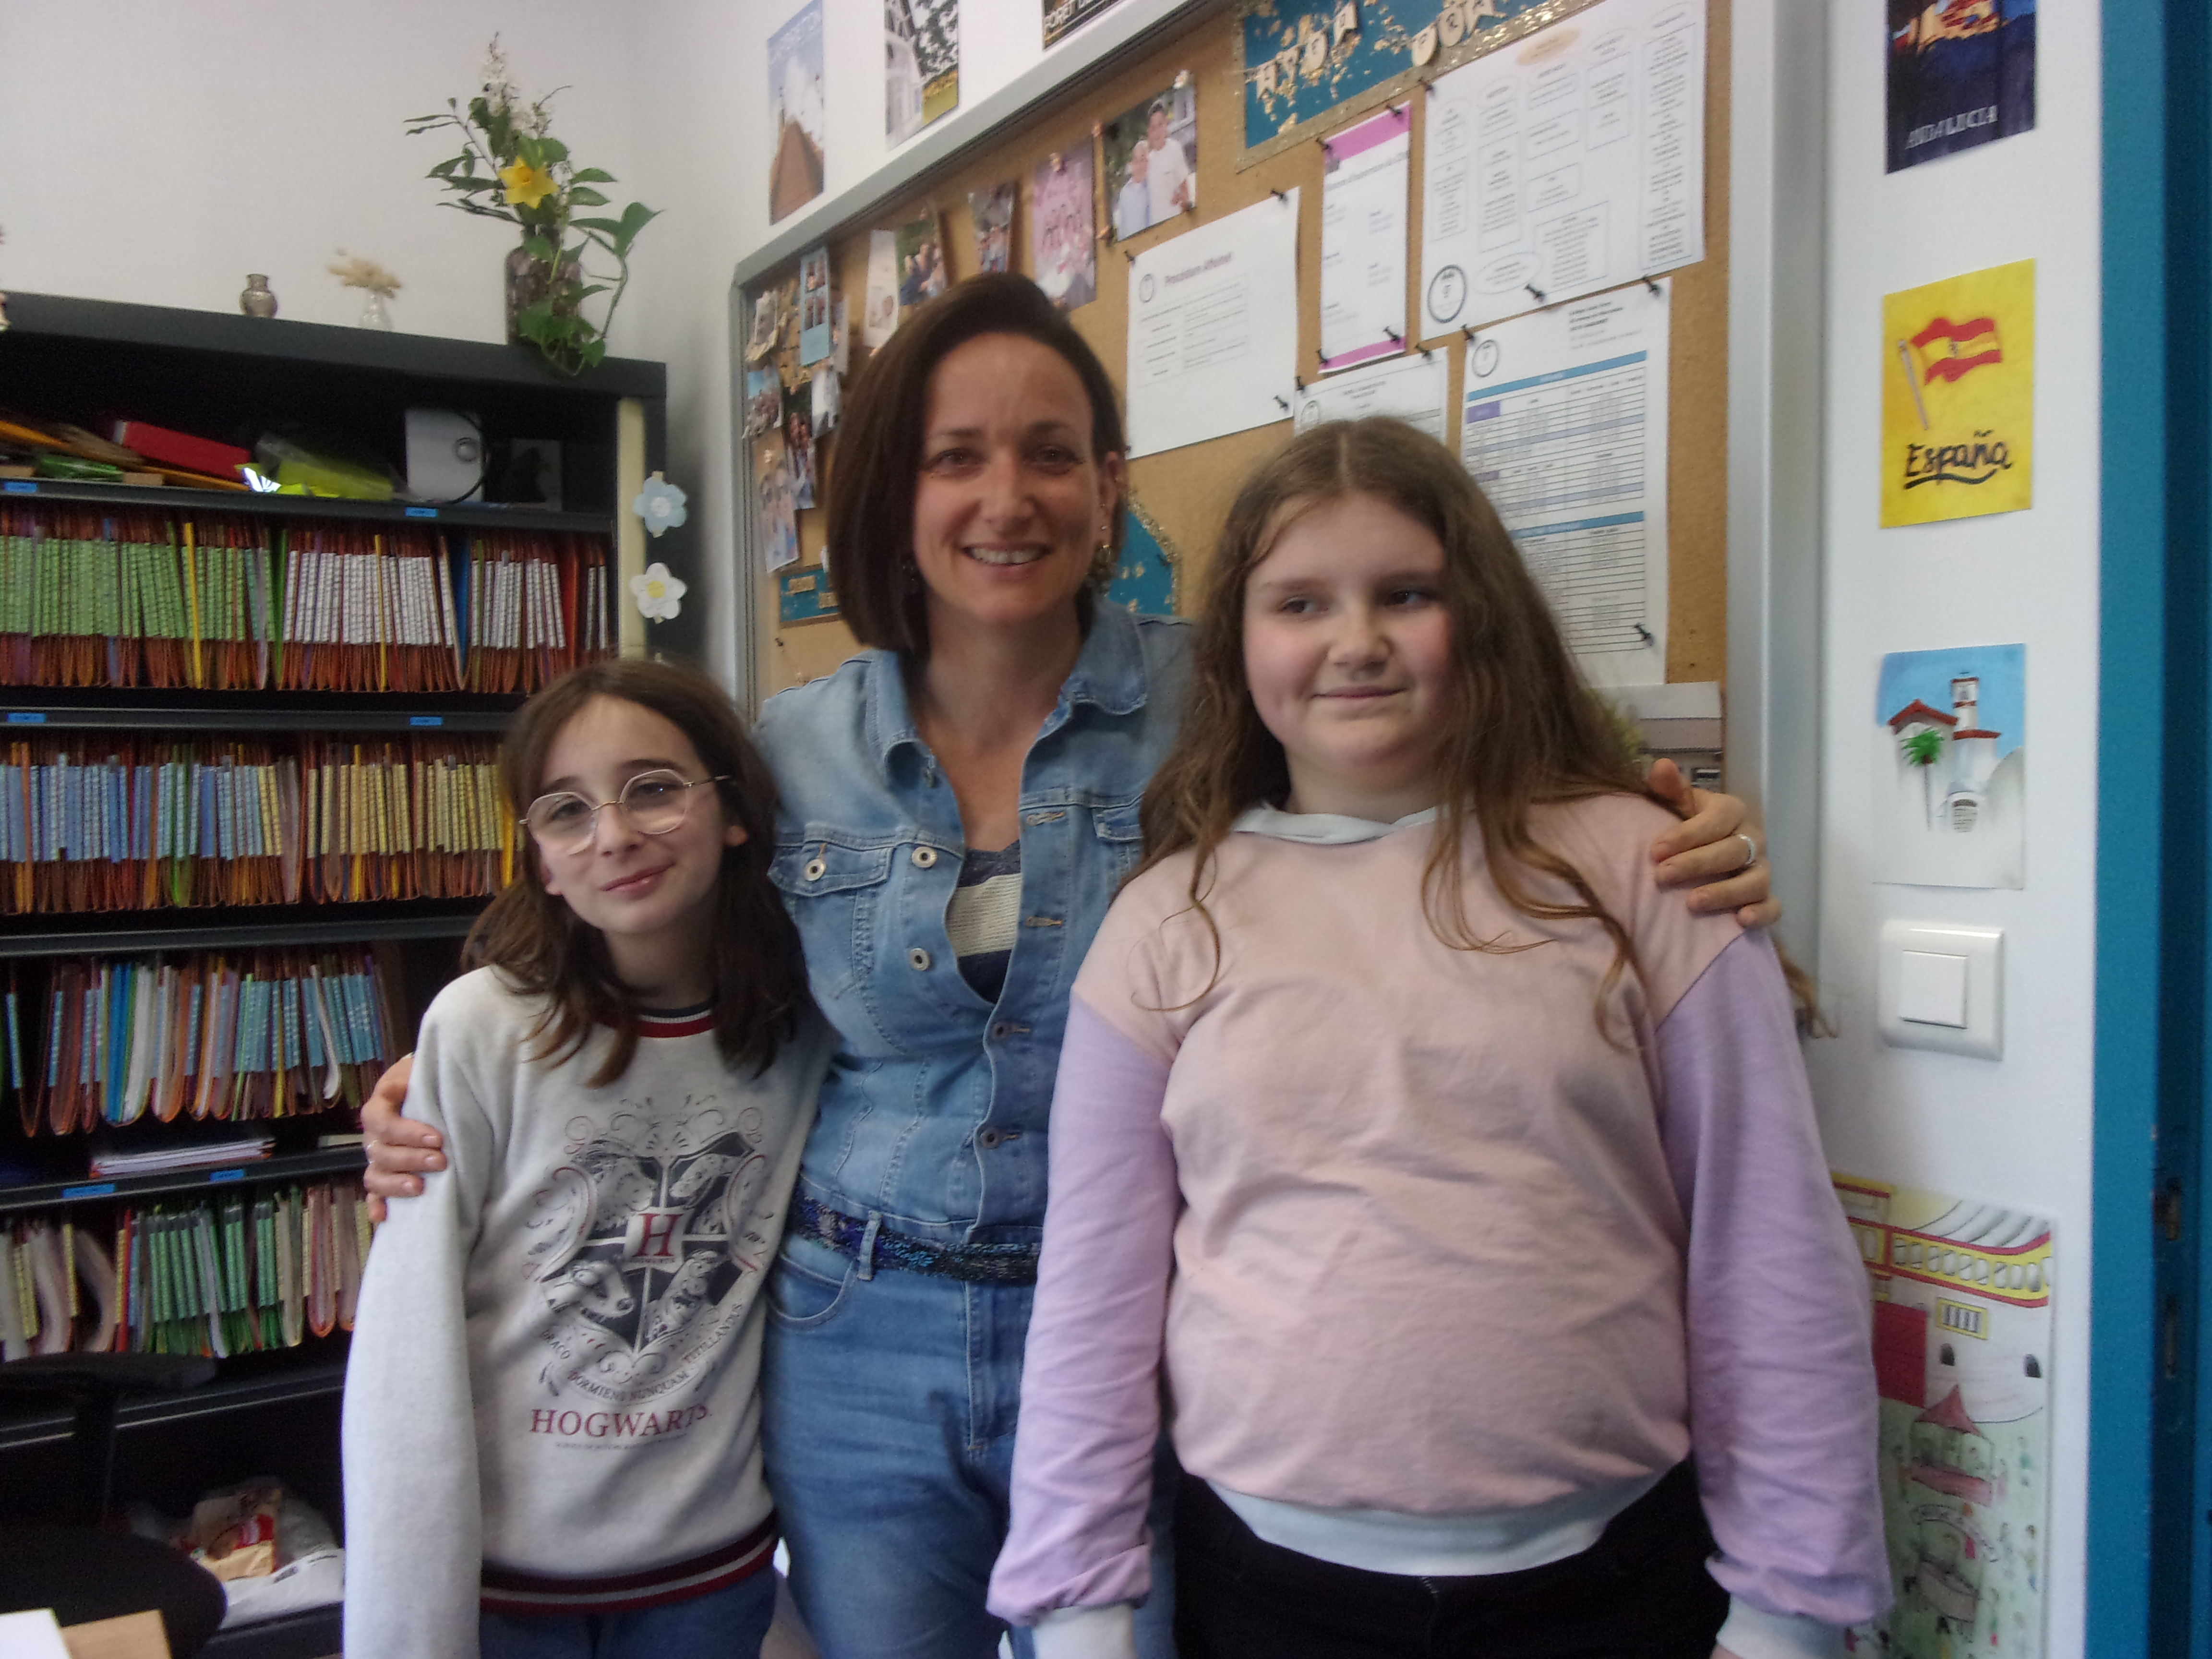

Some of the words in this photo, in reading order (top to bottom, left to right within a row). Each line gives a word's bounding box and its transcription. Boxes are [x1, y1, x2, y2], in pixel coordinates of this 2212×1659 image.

[1904, 429, 2012, 486] España
[632, 1213, 684, 1257] H
[529, 1403, 709, 1438] HOGWARTS
